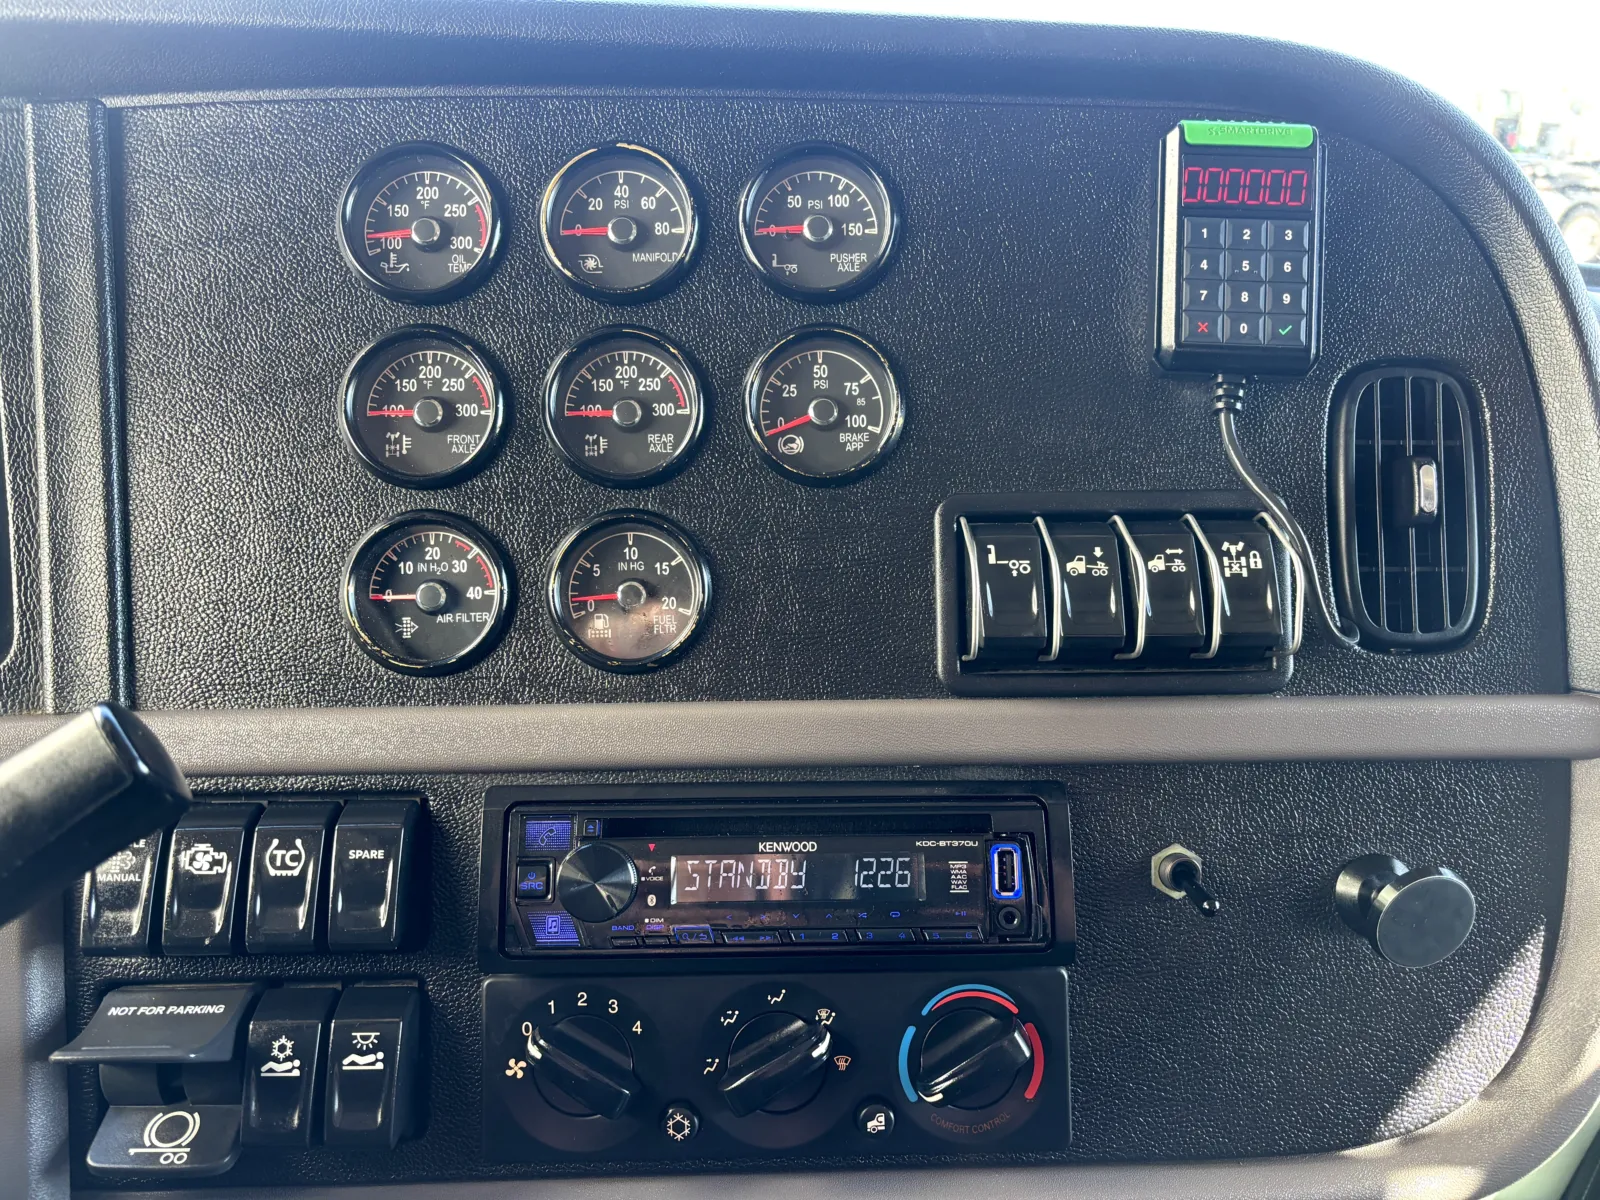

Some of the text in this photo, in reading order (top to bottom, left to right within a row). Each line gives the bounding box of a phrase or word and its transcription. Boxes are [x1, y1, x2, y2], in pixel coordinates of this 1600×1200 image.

[416, 187, 439, 199] 200
[614, 185, 629, 198] 40
[588, 198, 603, 211] 20
[614, 200, 630, 209] PSI
[641, 197, 656, 209] 60
[787, 196, 801, 208] 50
[808, 200, 823, 209] PSI
[828, 195, 849, 207] 100
[387, 205, 409, 217] 150
[444, 204, 467, 217] 250
[655, 222, 670, 235] 80
[841, 223, 863, 235] 150
[1201, 228, 1207, 238] 1
[1243, 229, 1251, 239] 2
[1284, 230, 1292, 240] 3
[380, 237, 402, 250] 100
[450, 237, 472, 249] 300
[452, 254, 466, 264] OIL
[632, 252, 678, 262] MANIFOLD
[830, 253, 867, 262] PUSHER
[837, 263, 860, 272] AXLE
[1200, 260, 1208, 270] 4
[1242, 261, 1249, 271] 5
[1284, 262, 1292, 272] 6
[1200, 290, 1208, 301] 7
[1241, 292, 1249, 302] 8
[1283, 294, 1290, 304] 9
[1240, 323, 1247, 334] 0
[419, 366, 441, 379] 200
[615, 366, 637, 379] 200
[813, 365, 828, 378] 50
[395, 379, 417, 391] 150
[442, 379, 465, 391] 250
[592, 379, 613, 391] 150
[638, 378, 661, 391] 250
[782, 384, 797, 397] 25
[814, 380, 828, 389] PSI
[844, 383, 859, 395] 75
[857, 398, 866, 406] 85
[455, 404, 478, 417] 300
[652, 404, 674, 416] 300
[778, 417, 784, 428] 0
[845, 415, 866, 427] 100
[447, 435, 480, 444] FRONT
[648, 434, 674, 443] REAR
[840, 433, 869, 442] BRAKE
[451, 444, 475, 453] AXLE
[649, 443, 673, 452] AXLE
[846, 443, 863, 451] APP
[425, 547, 440, 560] 20
[624, 547, 638, 560] 10
[399, 562, 413, 574] 10
[418, 563, 427, 571] IN
[452, 560, 467, 573] 30
[593, 564, 600, 577] 5
[618, 562, 644, 571] IN HG
[654, 562, 669, 575] 15
[385, 589, 392, 602] 0
[467, 587, 482, 599] 40
[588, 600, 594, 611] 0
[662, 597, 676, 610] 20
[436, 612, 489, 623] AIR FILTER
[653, 615, 677, 624] FUEL
[654, 625, 676, 634] FLTR
[758, 841, 817, 852] KENWOOD
[273, 850, 299, 867] TC
[349, 850, 385, 860] SPARE
[97, 873, 141, 882] MANUAL
[684, 859, 807, 891] STANDBY
[520, 882, 543, 890] SRC
[577, 992, 588, 1006] 2
[108, 1005, 225, 1016] NOT FOR PARKING
[548, 1000, 555, 1014] 1
[608, 1000, 618, 1014] 3
[522, 1022, 532, 1036] 0
[632, 1021, 642, 1034] 4
[930, 1112, 1011, 1134] COMFORT CONTROL
